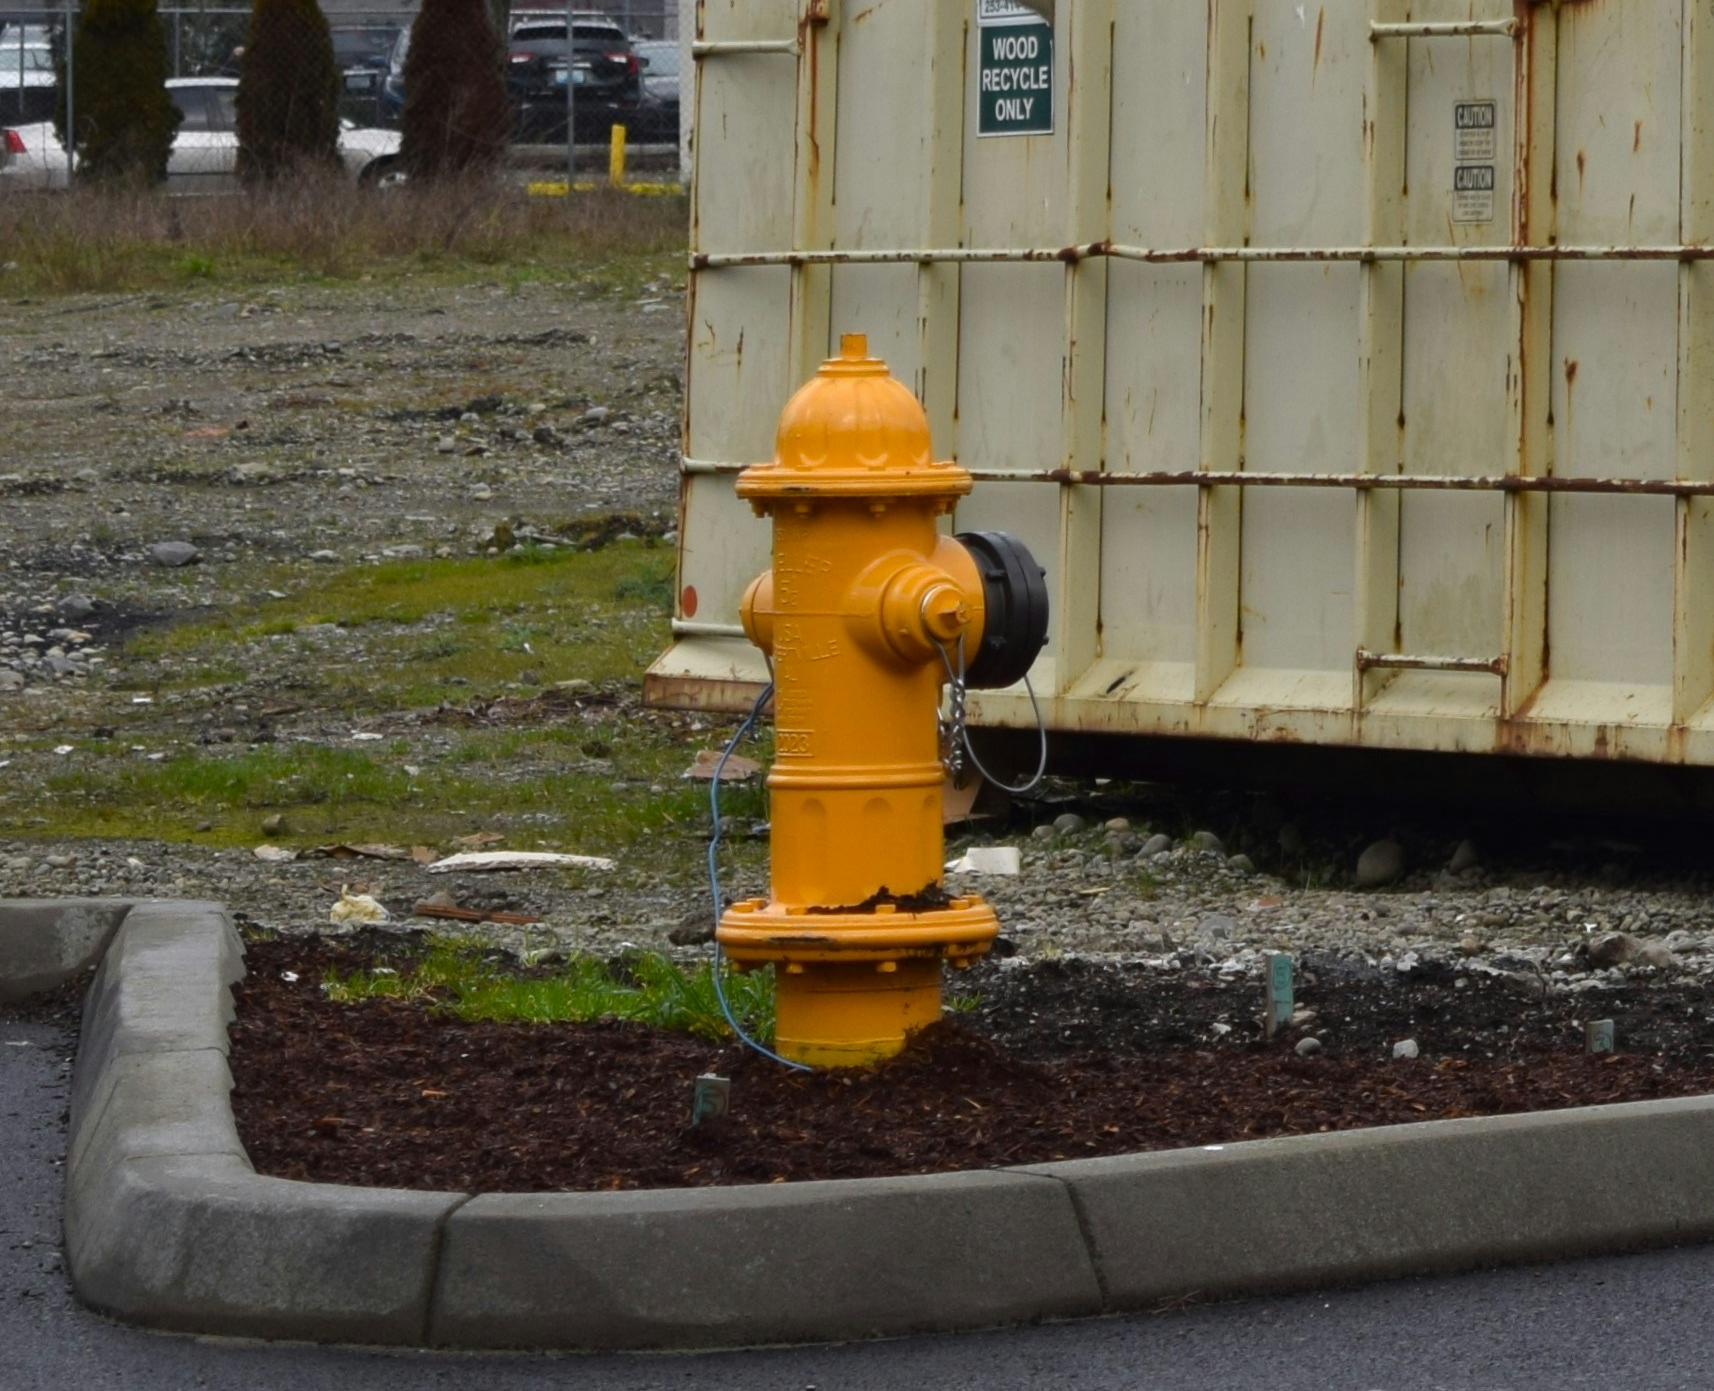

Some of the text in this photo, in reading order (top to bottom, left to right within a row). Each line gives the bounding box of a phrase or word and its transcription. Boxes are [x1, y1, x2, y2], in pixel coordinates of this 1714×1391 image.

[992, 35, 1038, 60] WOOD
[982, 66, 1049, 91] RECYCLE
[995, 97, 1034, 121] ONLY
[1457, 106, 1492, 127] CAUTION
[1456, 168, 1492, 189] CAUTION
